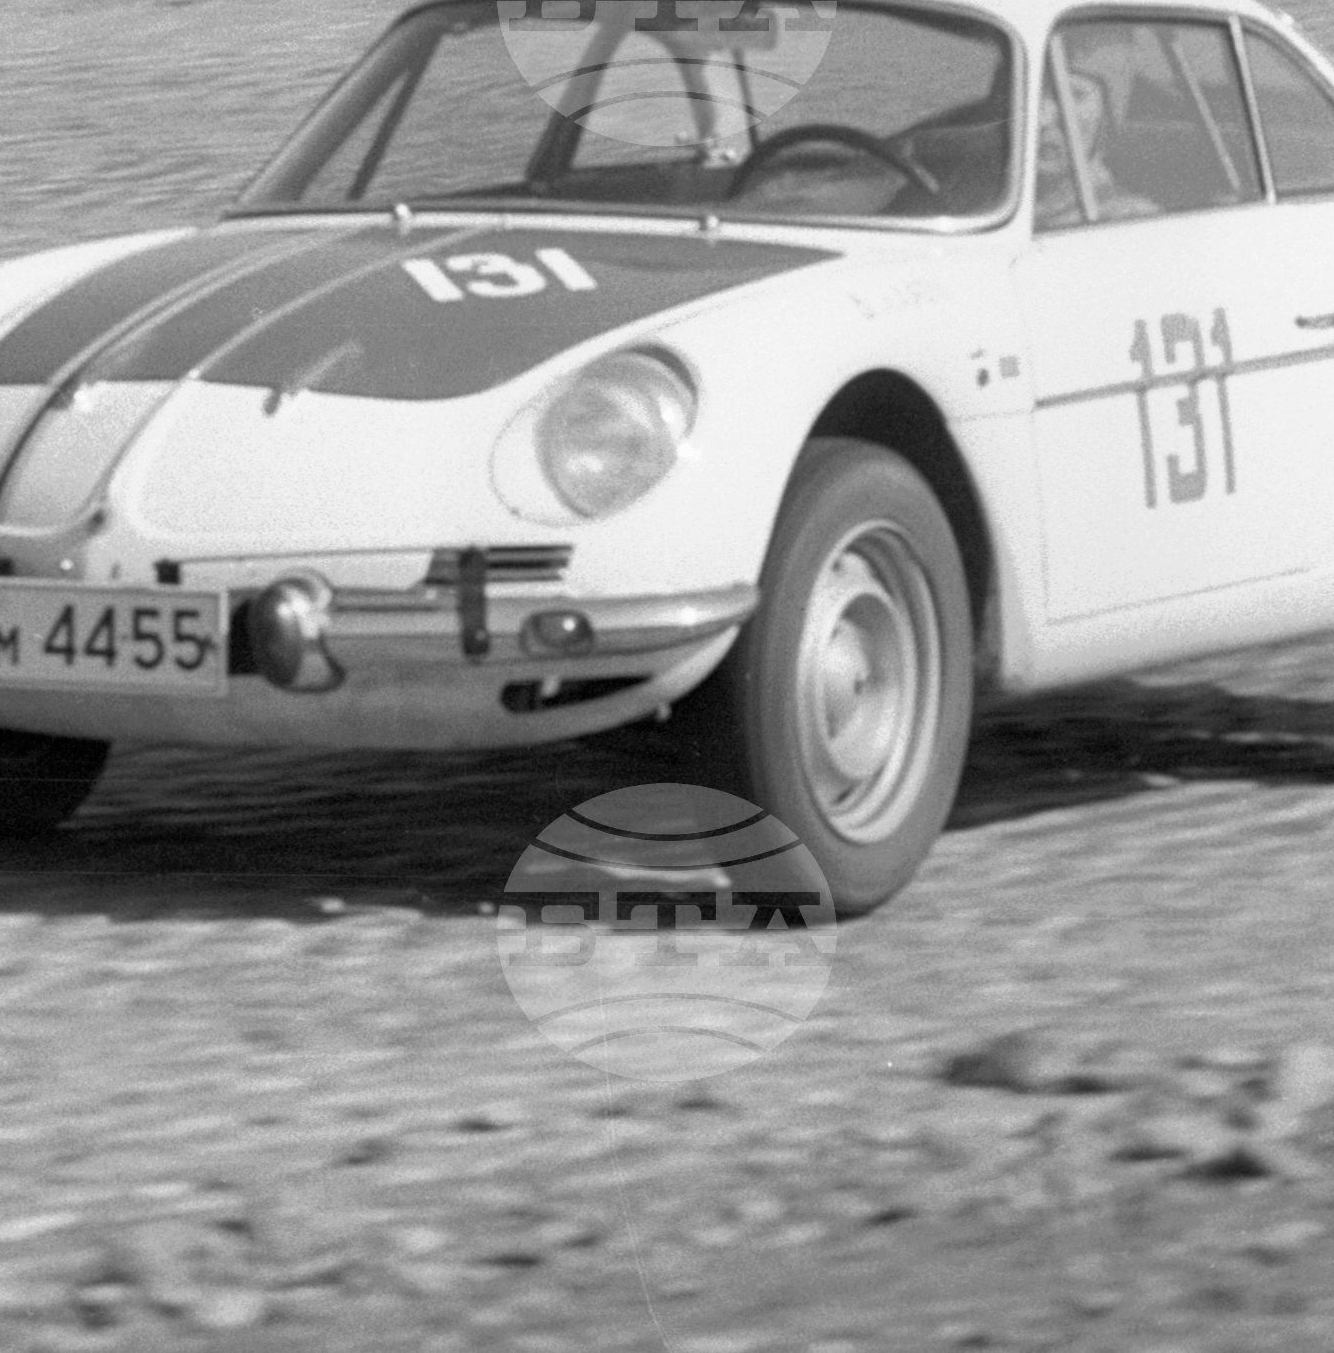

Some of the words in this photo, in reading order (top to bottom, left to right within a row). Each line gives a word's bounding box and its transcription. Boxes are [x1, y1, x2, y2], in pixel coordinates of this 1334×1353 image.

[401, 247, 598, 303] 131
[1129, 307, 1237, 509] 131
[43, 603, 207, 671] 4455
